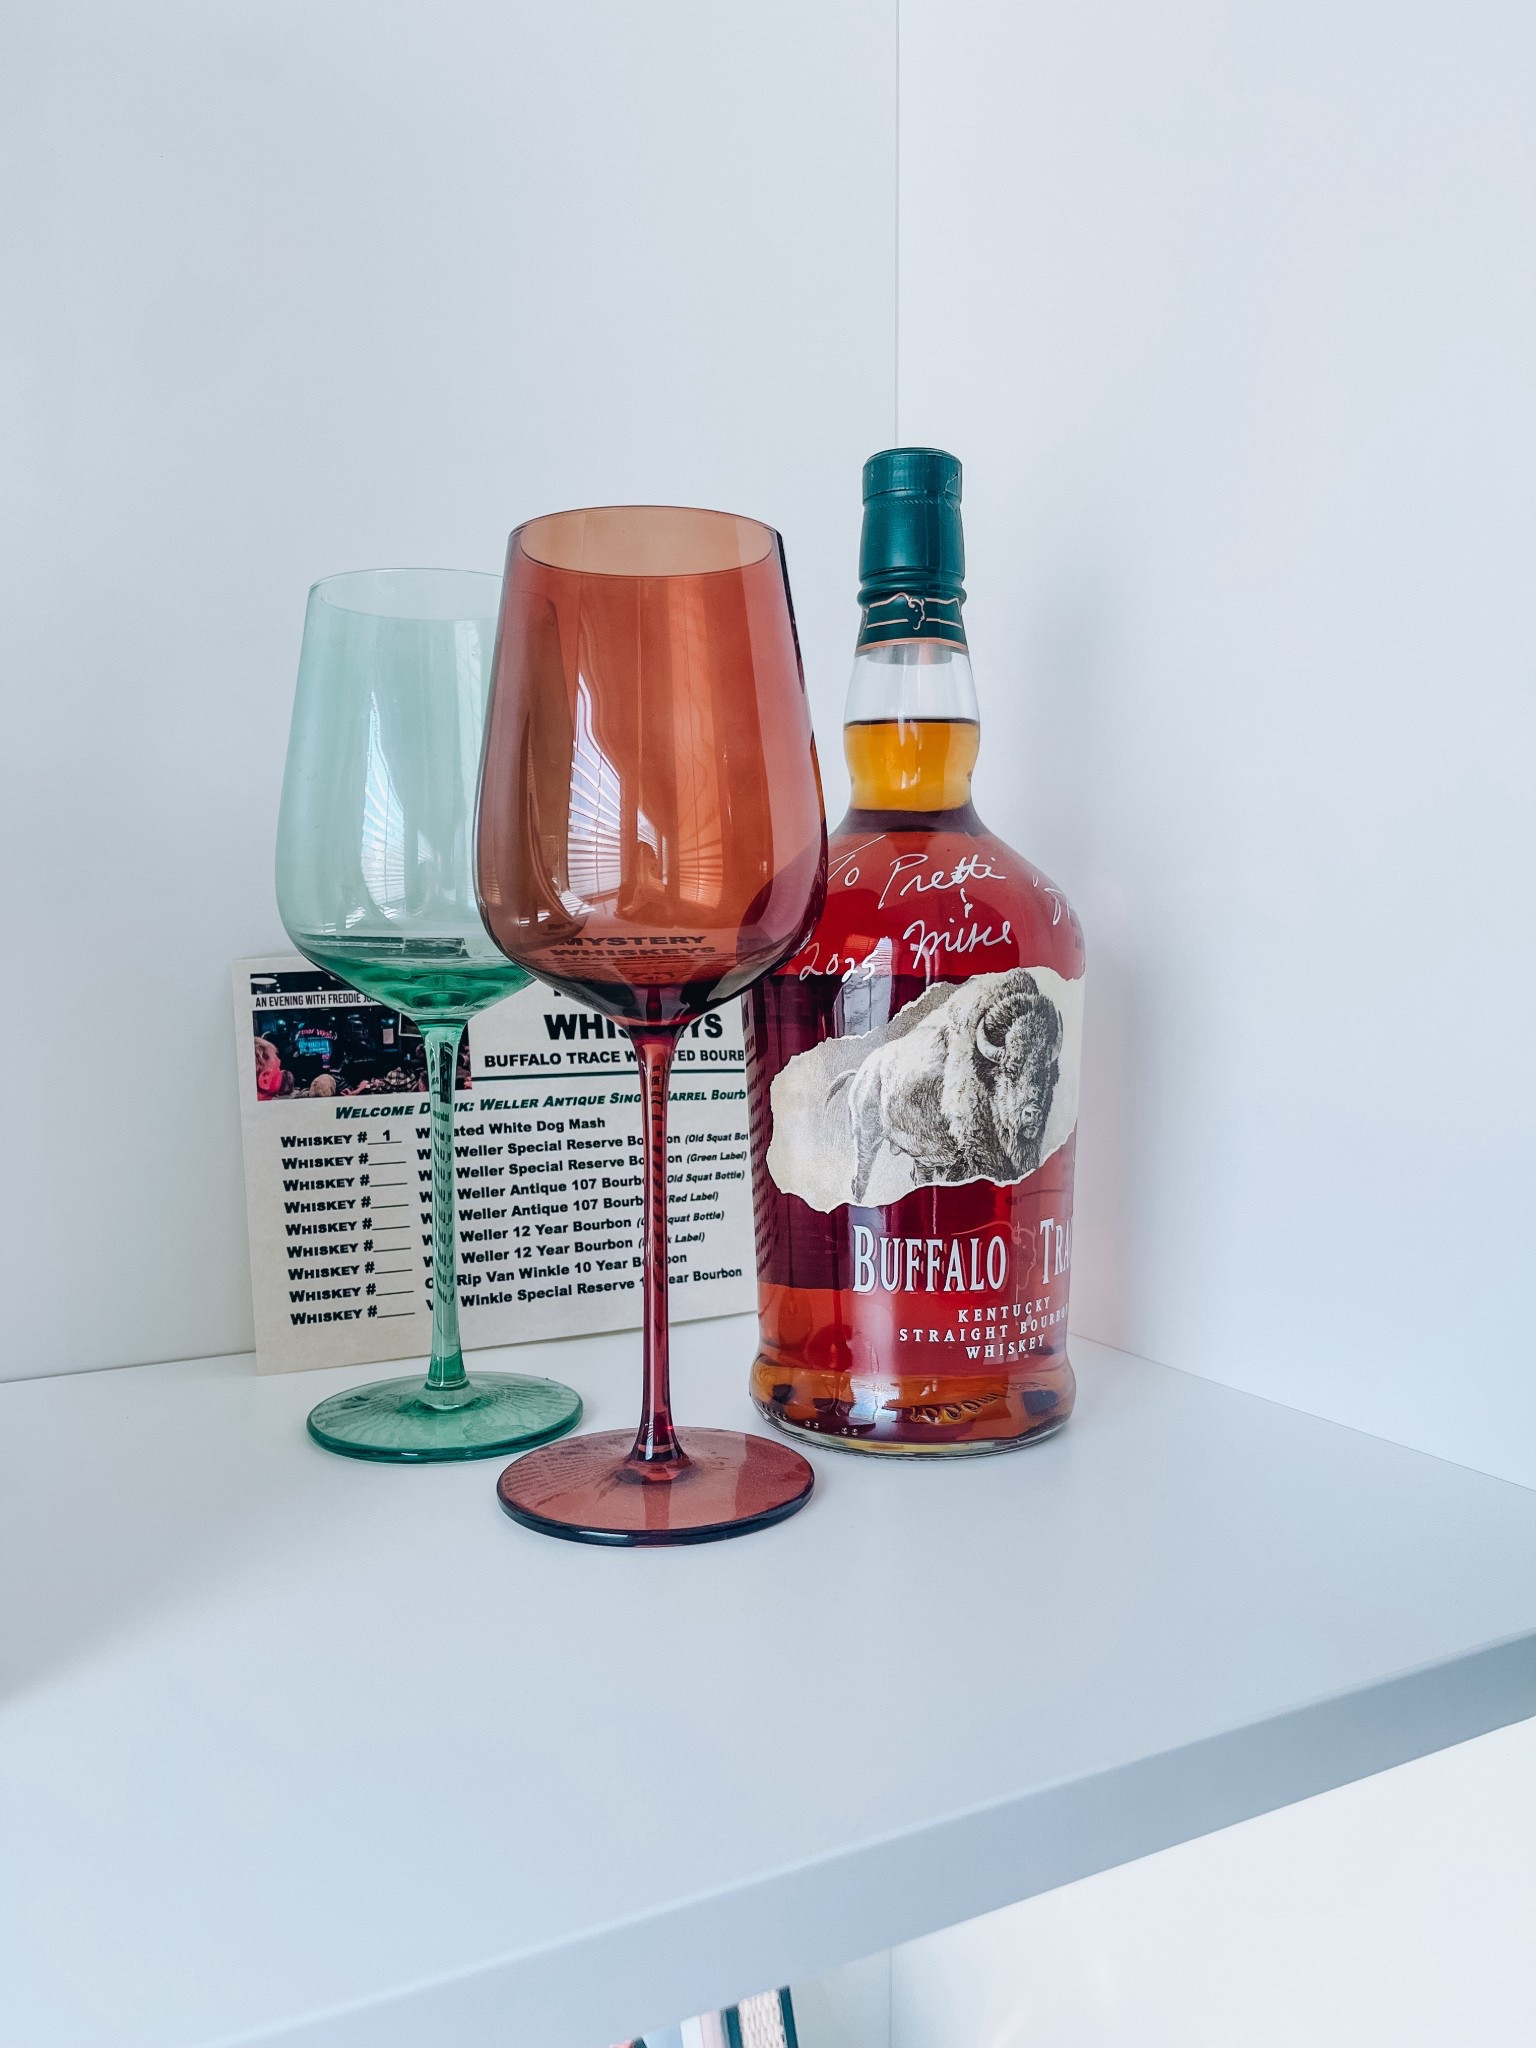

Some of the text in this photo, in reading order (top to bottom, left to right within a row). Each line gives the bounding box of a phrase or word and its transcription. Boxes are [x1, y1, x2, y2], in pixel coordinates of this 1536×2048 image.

[550, 946, 715, 956] WHISKEYS
[557, 936, 707, 946] MYSTERY
[799, 943, 879, 982] 2025
[255, 997, 268, 1008] AN
[269, 995, 304, 1007] EVENING
[305, 994, 327, 1005] WITH
[328, 993, 361, 1004] FREDDIE
[543, 1013, 723, 1040] WHIYS
[484, 1049, 745, 1068] BUFFALO TRACE WTED BOURB
[335, 1105, 414, 1120] WELCOME
[480, 1098, 539, 1111] WELLER
[543, 1095, 606, 1108] ANTIQUE
[610, 1092, 641, 1104] SING
[711, 1089, 746, 1100] Bourb
[415, 1117, 606, 1139] Wated White Dog Mash
[280, 1135, 352, 1148] WHISKEY
[455, 1145, 503, 1158] Weller
[508, 1140, 562, 1157] Special
[566, 1136, 623, 1151] Reserve
[628, 1135, 681, 1146] Boon
[685, 1134, 704, 1144] (Old
[707, 1132, 732, 1143] Squat
[282, 1156, 354, 1170] WHISKEY
[456, 1166, 504, 1179] Weller
[508, 1161, 563, 1178] Special
[568, 1157, 625, 1171] Reserve
[687, 1153, 717, 1164] (Green
[720, 1151, 747, 1161] Label)
[283, 1178, 355, 1191] WHISKEY
[457, 1170, 745, 1200] Weller Antique 107 Bourb Old Squat Bottle)
[284, 1199, 356, 1214] WHISKEY
[459, 1191, 719, 1221] Weller Antique 107 Bourb Red Label)
[285, 1221, 357, 1236] WHISKEY
[460, 1229, 508, 1242] Weller
[513, 1225, 531, 1238] 12
[535, 1223, 569, 1237] Year
[573, 1217, 632, 1233] Bourbon
[667, 1214, 690, 1225] quat
[693, 1211, 725, 1221] Bottle)
[286, 1243, 358, 1258] WHISKEY
[461, 1250, 510, 1264] Weller
[514, 1246, 532, 1259] 12
[536, 1243, 570, 1258] Year
[574, 1238, 633, 1254] Bourbon
[675, 1232, 705, 1243] Label)
[852, 1218, 1072, 1293] BUFFALO TRA
[288, 1265, 360, 1280] WHISKEY
[457, 1273, 482, 1287] Rip
[486, 1271, 515, 1282] Van
[519, 1264, 570, 1281] Winkle
[574, 1261, 592, 1274] 10
[596, 1258, 629, 1272] Year
[289, 1287, 361, 1303] WHISKEY
[460, 1292, 512, 1307] Winkle
[517, 1284, 572, 1302] Special
[577, 1279, 635, 1295] Reserve
[668, 1273, 689, 1285] ear
[693, 1268, 742, 1282] Bourbon
[290, 1309, 363, 1325] WHISKEY
[957, 1296, 1051, 1323] KENTUCKY
[899, 1303, 1069, 1343] STRAIGHT BOURBO
[965, 1334, 1046, 1359] WHISKEY
